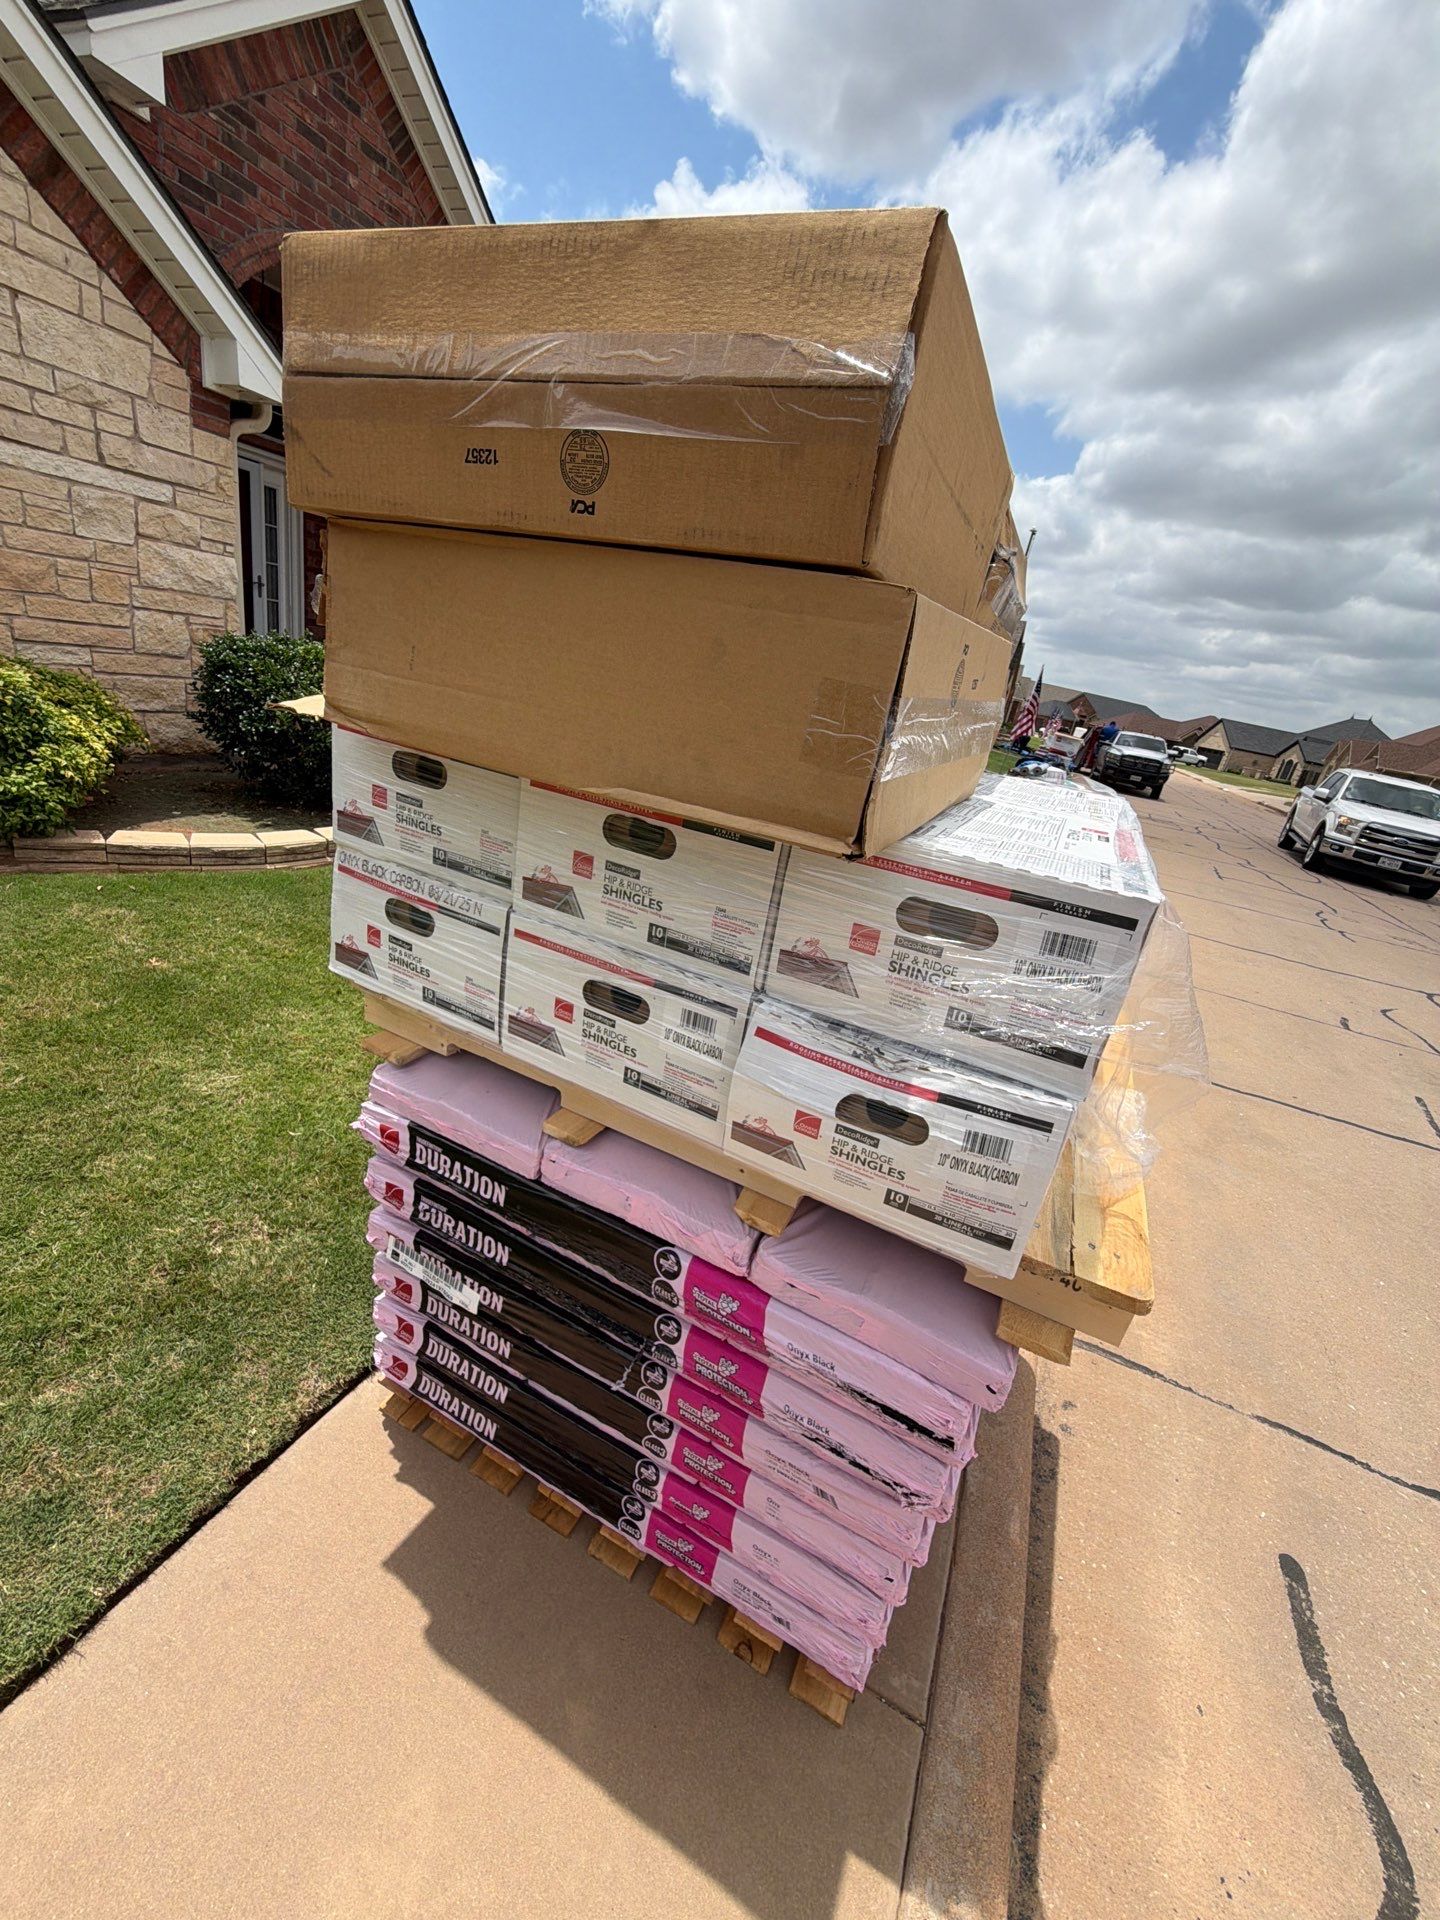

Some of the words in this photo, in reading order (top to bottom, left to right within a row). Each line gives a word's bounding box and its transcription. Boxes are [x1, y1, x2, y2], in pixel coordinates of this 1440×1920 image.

[465, 448, 499, 465] 12357
[570, 499, 596, 516] PCA
[395, 813, 442, 837] SHINGLES
[434, 849, 445, 860] 10
[338, 851, 360, 870] ONYX
[361, 859, 388, 881] BLACK
[389, 869, 426, 895] CARBON
[473, 904, 483, 917] N
[603, 873, 618, 885] HIP
[619, 878, 625, 887] &
[626, 880, 654, 897] RIDGE
[939, 873, 972, 887] SYSTEM
[602, 884, 663, 912] SHINGLES
[1052, 901, 1092, 916] FINISH
[650, 925, 664, 938] 10
[897, 936, 938, 955] DecoRidge
[388, 953, 431, 978] SHINGLES
[403, 951, 422, 965] RIDGE
[891, 949, 910, 962] HIP
[911, 956, 920, 966] &
[922, 958, 959, 977] RIDGE
[888, 960, 971, 995] SHINGLES
[951, 1008, 967, 1022] 10
[581, 1029, 637, 1058] SHINGLES
[582, 1020, 595, 1031] HIP
[597, 1025, 602, 1033] &
[603, 1027, 629, 1043] RIDGE
[673, 1030, 686, 1047] ONYX
[685, 1036, 724, 1061] BLACK/CARBON
[626, 1070, 638, 1081] 10
[789, 1041, 822, 1058] ROOFING
[877, 1075, 906, 1089] SYSTEM
[976, 1104, 1011, 1118] FINISH
[836, 1126, 875, 1145] DecoRidge
[830, 1145, 906, 1181] SHINGLES
[832, 1137, 849, 1149] HIP
[851, 1144, 858, 1154] &
[861, 1148, 894, 1166] RIDGE
[415, 1142, 507, 1207] DURATION
[937, 1153, 950, 1167] 10"
[950, 1157, 969, 1174] ONYX
[968, 1162, 1020, 1187] BLACK/CARBON
[888, 1191, 905, 1204] 10
[418, 1201, 510, 1267] DURATION
[943, 1217, 972, 1233] LINEAL
[426, 1295, 512, 1359] DURATION
[425, 1337, 509, 1404] DURATION
[787, 1342, 810, 1362] Onyx
[812, 1353, 836, 1373] Black
[695, 1364, 750, 1398] PROTECTION
[418, 1374, 497, 1441] DURATION
[783, 1404, 804, 1423] Onyx
[807, 1417, 831, 1436] Black
[679, 1409, 731, 1443] PROTECTION
[684, 1457, 733, 1490] PROTECTION
[657, 1538, 703, 1572] PROTECTION
[733, 1578, 751, 1594] Onyx
